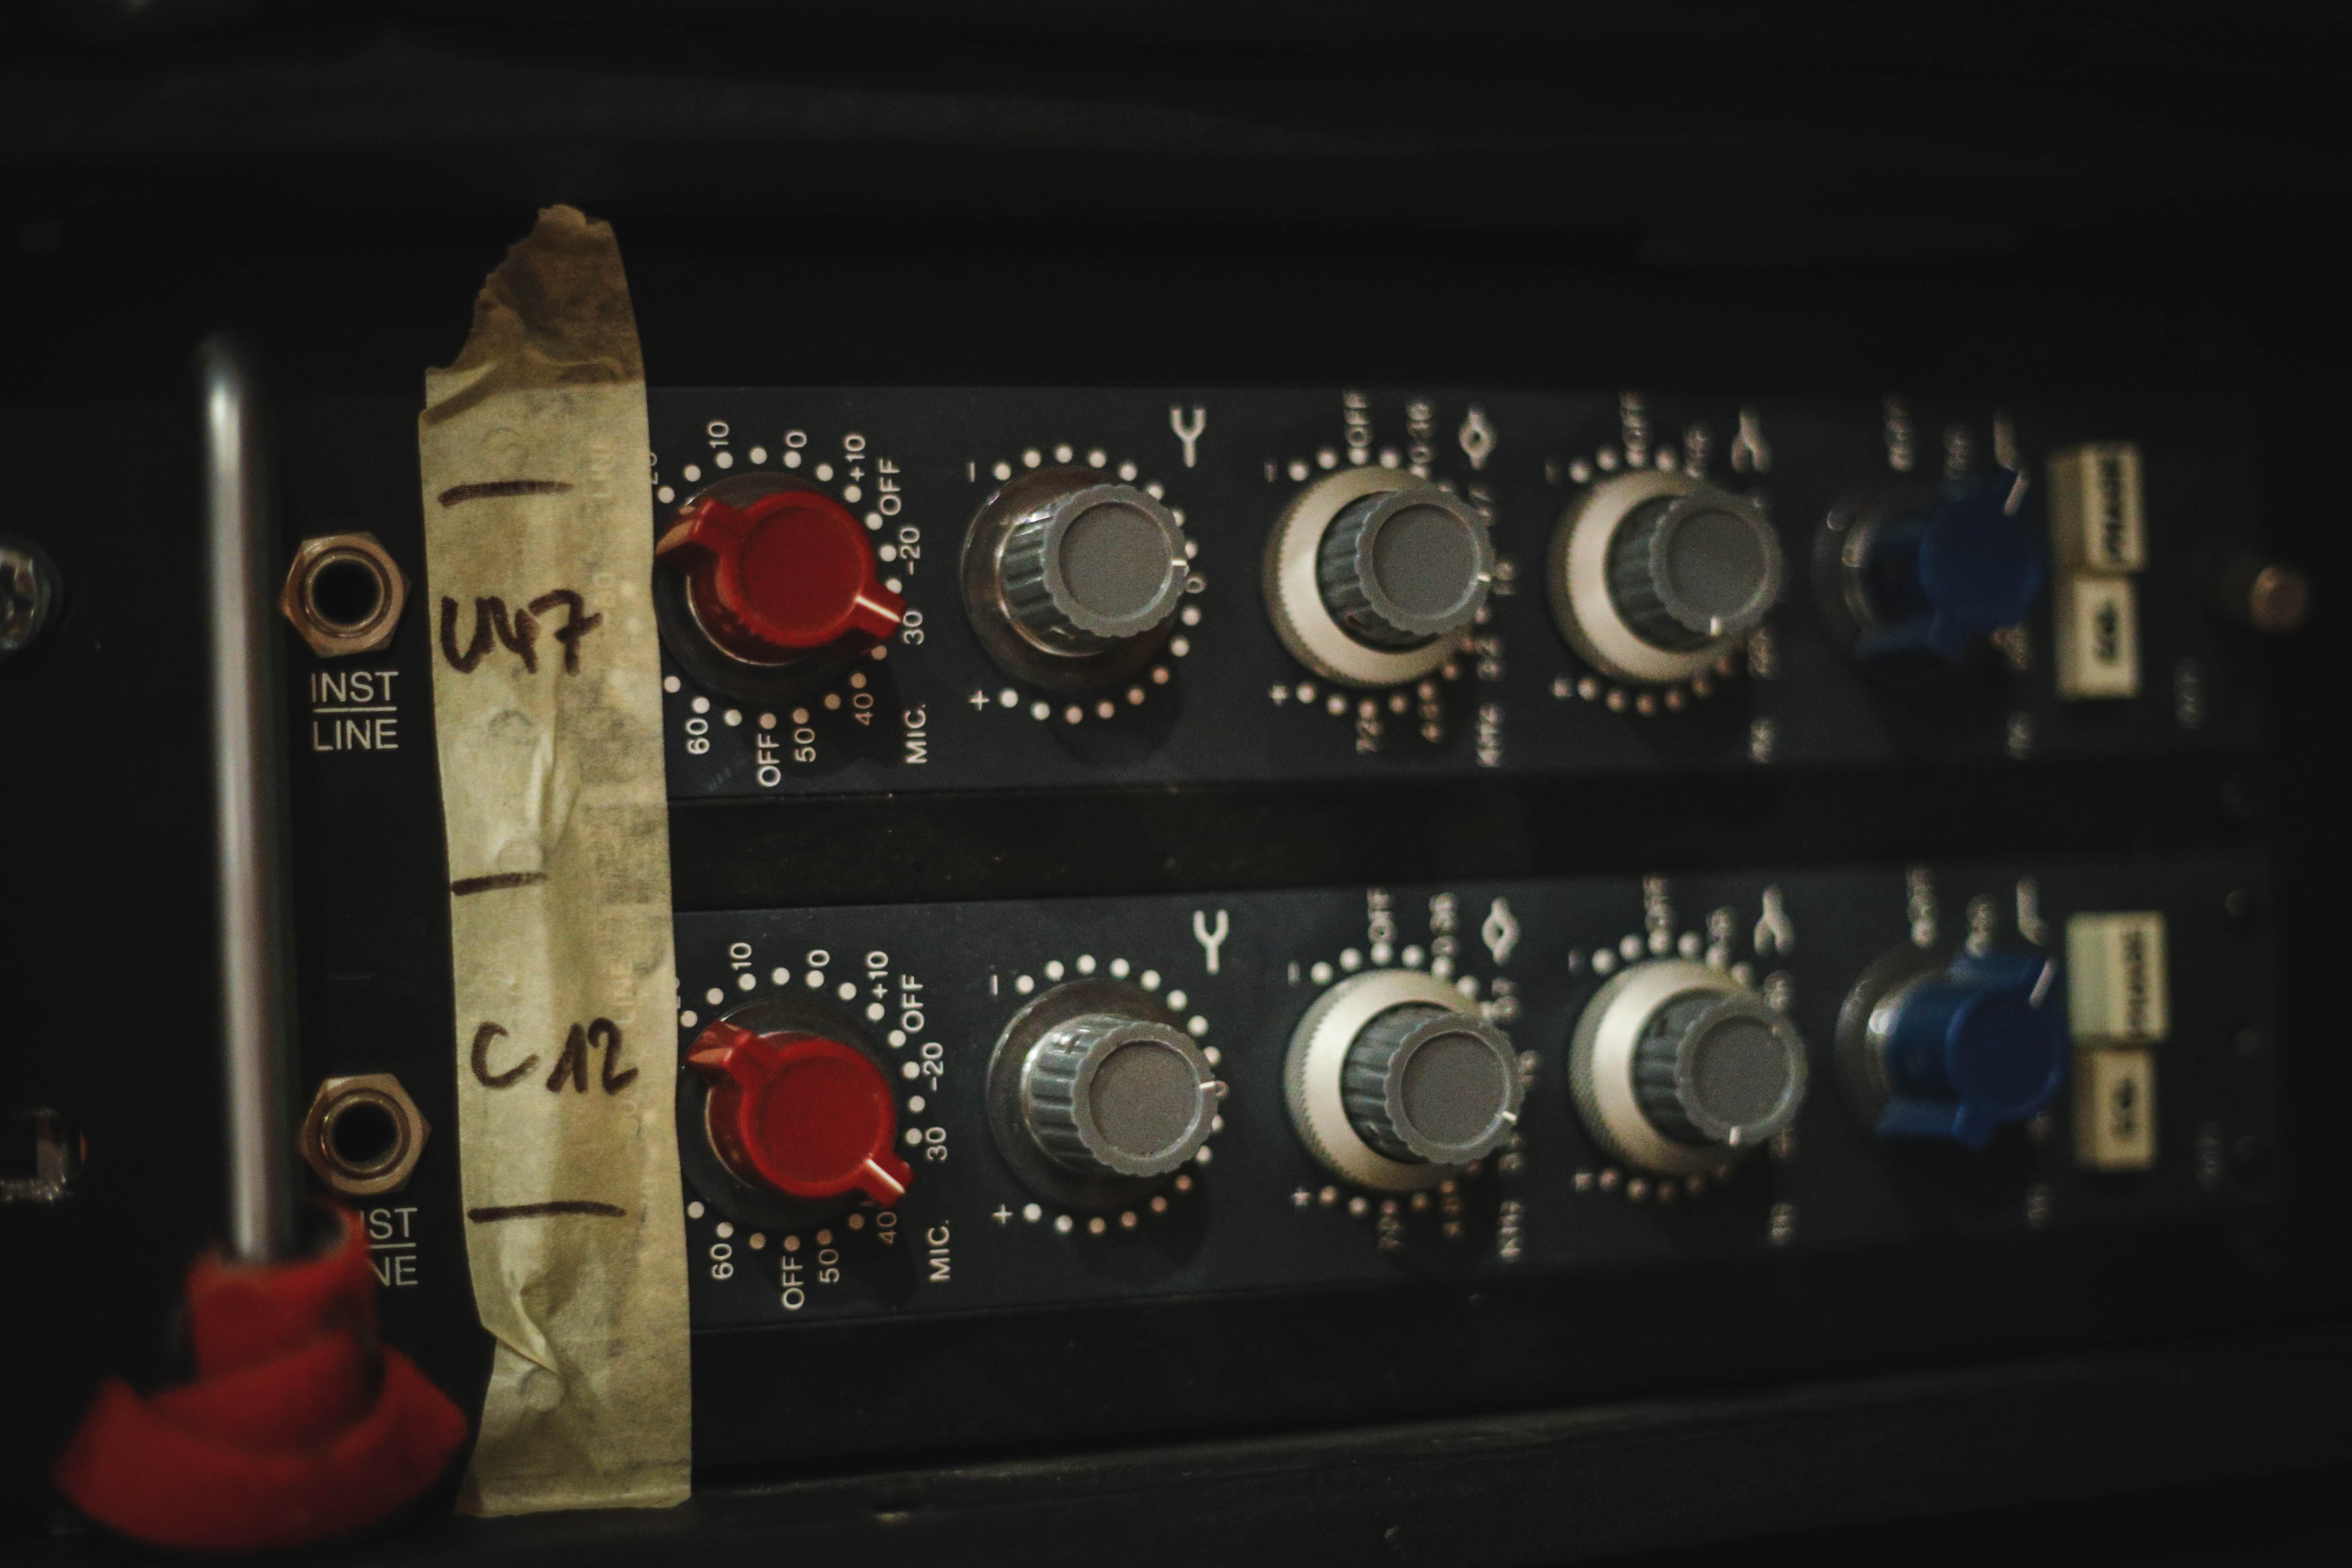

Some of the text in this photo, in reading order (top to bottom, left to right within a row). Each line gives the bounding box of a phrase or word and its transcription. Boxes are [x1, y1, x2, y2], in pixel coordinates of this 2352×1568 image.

[707, 420, 729, 449] 10
[784, 430, 807, 448] 0
[843, 433, 866, 481] +10
[877, 458, 902, 517] OFF
[898, 526, 921, 575] -20
[901, 609, 925, 645] 30
[312, 671, 399, 703] INST
[852, 693, 874, 726] 40
[313, 718, 399, 751] LINE
[686, 717, 710, 755] 60
[793, 728, 816, 762] 50
[904, 703, 928, 764] MIC.
[756, 733, 781, 787] OFF
[729, 942, 752, 970] 10
[807, 949, 830, 968] 0
[866, 950, 889, 999] +10
[900, 974, 925, 1033] OFF
[921, 1042, 944, 1091] -20
[925, 1127, 948, 1161] 30
[359, 1207, 418, 1240] ST
[876, 1211, 897, 1245] 40
[709, 1243, 734, 1280] 60
[818, 1249, 840, 1283] 50
[927, 1220, 951, 1282] MIC.
[781, 1256, 805, 1311] OFF
